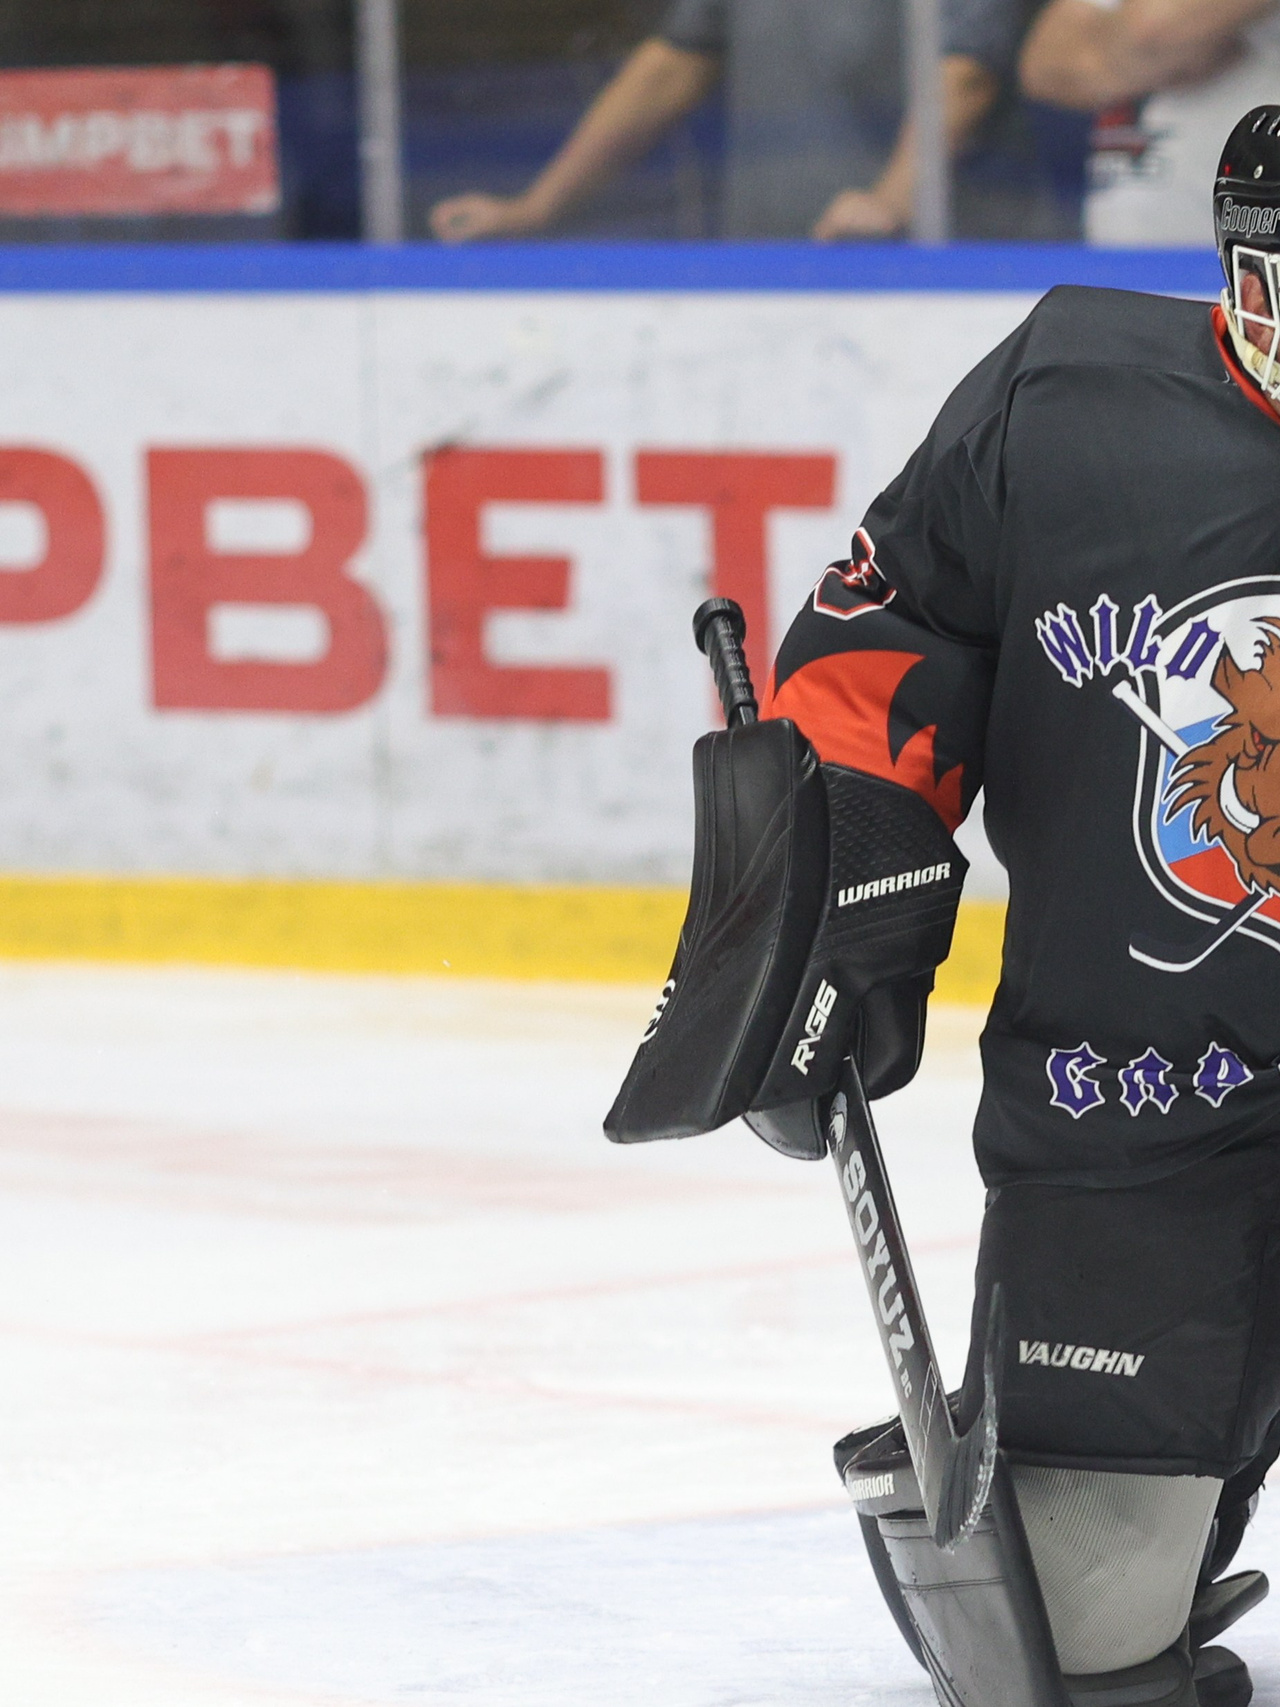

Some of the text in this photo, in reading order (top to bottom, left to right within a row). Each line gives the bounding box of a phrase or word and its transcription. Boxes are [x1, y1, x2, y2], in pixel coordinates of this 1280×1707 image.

[837, 861, 952, 908] WARRIOR
[842, 1150, 915, 1370] SOYUZ
[1017, 1340, 1146, 1378] VAUGHN
[849, 1472, 895, 1501] ARRIOR
